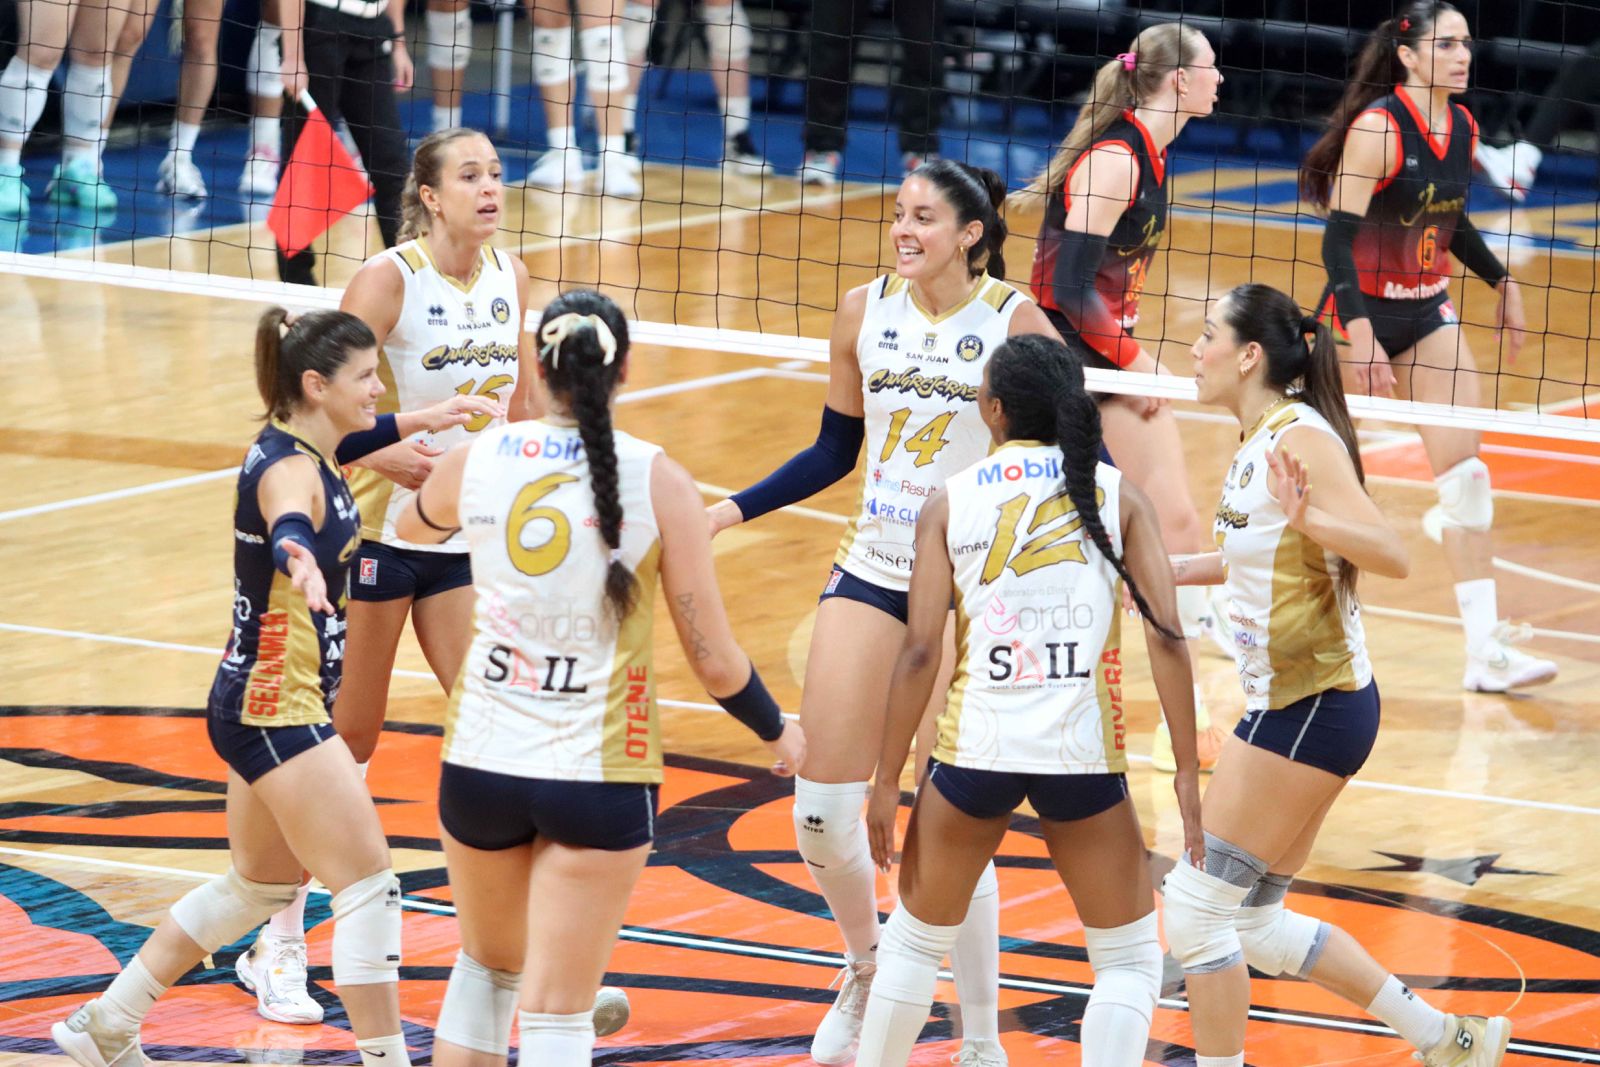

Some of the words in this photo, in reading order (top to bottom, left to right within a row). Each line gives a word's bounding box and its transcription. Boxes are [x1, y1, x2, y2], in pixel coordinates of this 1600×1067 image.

[1417, 225, 1439, 270] 6
[427, 317, 449, 326] errea
[457, 323, 473, 331] SAN
[878, 340, 899, 351] errea
[905, 352, 924, 360] SAN
[925, 355, 949, 364] JUAN
[498, 433, 583, 460] Mobil
[879, 406, 958, 469] 14
[977, 456, 1059, 486] Mobil
[506, 471, 581, 577] 6
[880, 503, 896, 518] PR
[979, 485, 1106, 586] 12
[984, 592, 1094, 636] Gordo
[989, 639, 1091, 684] SAIL
[624, 665, 649, 760] OTENE
[1102, 647, 1126, 751] RIVERA
